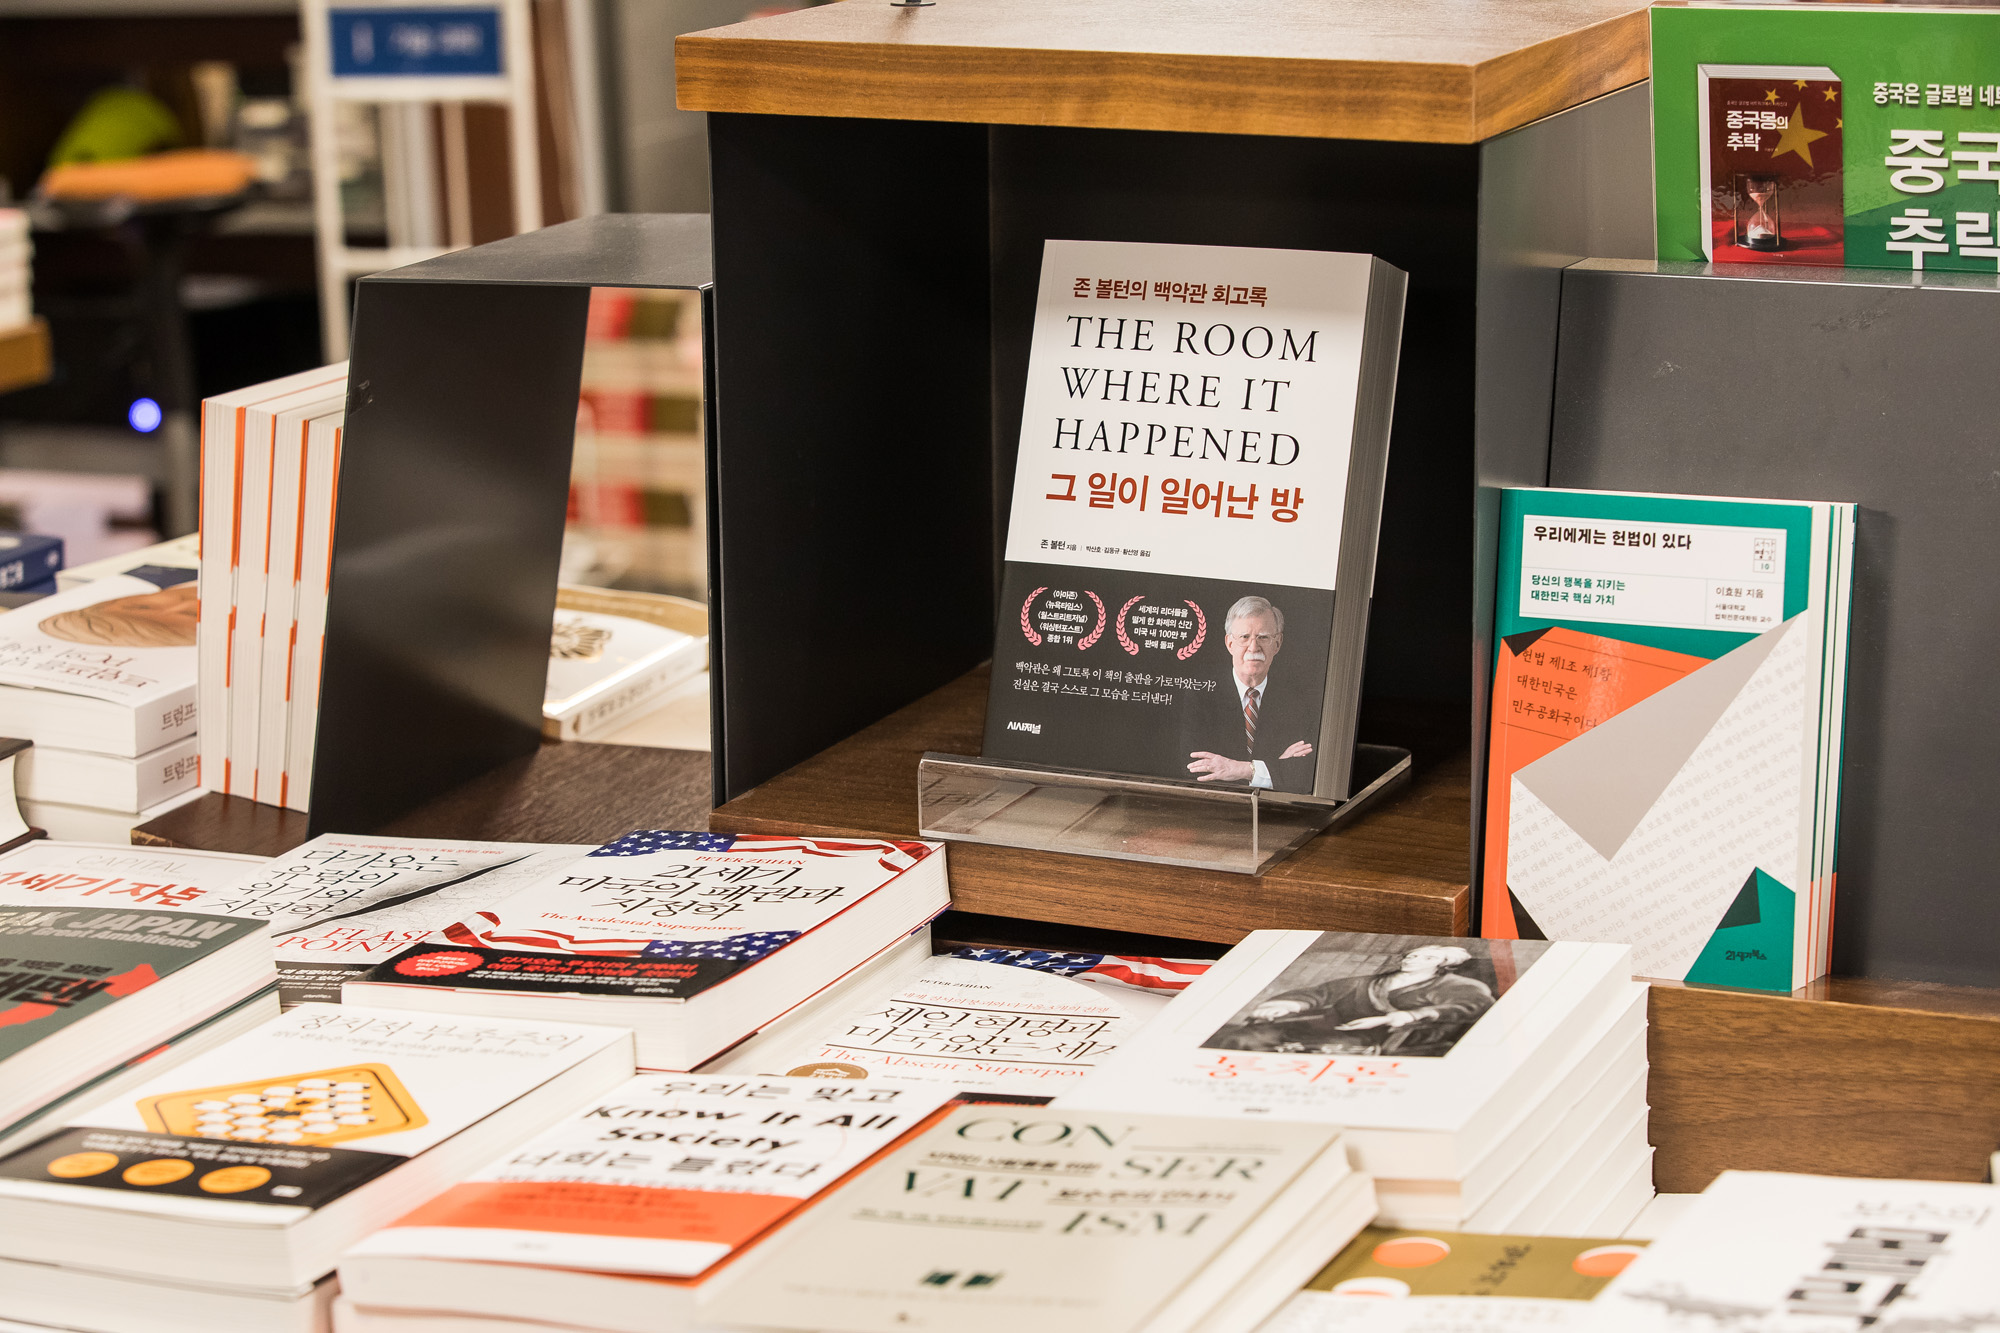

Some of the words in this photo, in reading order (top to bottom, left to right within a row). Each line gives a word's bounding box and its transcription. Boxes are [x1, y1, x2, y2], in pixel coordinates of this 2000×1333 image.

[1873, 82, 1920, 105] 중국은
[1925, 84, 1973, 106] 글로벌
[1979, 84, 2000, 107] 네
[1726, 110, 1788, 130] 중국몽의
[1727, 132, 1761, 152] 추락
[1073, 278, 1091, 298] 존
[1095, 278, 1148, 300] 볼턴의
[1153, 280, 1208, 304] 백악관
[1212, 285, 1268, 307] 회고록
[1066, 315, 1156, 352] THE
[1173, 321, 1320, 363] ROOM
[1060, 366, 1222, 408] WHERE
[1240, 378, 1291, 413] IT
[1052, 417, 1301, 466] HAPPENED
[1045, 473, 1077, 502] 그
[1088, 472, 1149, 511] 일이
[1160, 477, 1259, 520] 일어난
[1270, 487, 1304, 523] 방
[1041, 539, 1048, 548] 존
[1050, 540, 1065, 550] 볼턴
[1534, 525, 1607, 545] 우리에게는
[1612, 530, 1656, 548] 헌법이
[1662, 533, 1692, 550] 있다
[1531, 574, 1560, 587] 당신의
[1564, 576, 1592, 589] 행복을
[1596, 579, 1626, 591] 지키는
[1715, 587, 1743, 597] 이효원
[1746, 589, 1764, 599] 지음
[1531, 590, 1569, 602] 대한민국
[1573, 593, 1592, 604] 핵심
[1595, 594, 1615, 605] 가치
[1138, 605, 1159, 614] 세계의
[1161, 608, 1188, 618] 리더들을
[1147, 617, 1154, 625] 한
[1156, 618, 1176, 628] 화제의
[1178, 620, 1192, 629] 신간
[1047, 634, 1060, 643] 종합
[1063, 636, 1073, 644] 1위
[1134, 627, 1148, 636] 미국
[1150, 629, 1156, 637] 내
[1159, 630, 1178, 639] 100만
[1180, 632, 1187, 640] 부
[1145, 640, 1158, 648] 판매
[1160, 641, 1174, 650] 돌파
[1522, 649, 1545, 666] 헌법
[1549, 656, 1578, 672] 제1조
[1015, 661, 1050, 675] 백악관은
[1052, 665, 1062, 676] 왜
[1063, 667, 1091, 679] 그토록
[1092, 669, 1102, 680] 이
[1104, 670, 1122, 683] 책의
[1124, 671, 1153, 686] 출판을
[1013, 678, 1039, 692] 진실은
[1041, 681, 1060, 694] 결국
[1060, 684, 1088, 696] 스스로
[1090, 687, 1100, 697] 그
[1101, 688, 1130, 701] 모습을
[1131, 691, 1173, 705] 드러낸다!
[1517, 675, 1578, 700] 대한민국은
[161, 702, 197, 731] 트럼프
[1512, 700, 1598, 729] 민주공화국이다
[1007, 721, 1042, 735] 시사저널
[163, 755, 199, 784] 트럼프
[77, 855, 187, 874] CAPITAL
[303, 850, 459, 873] 다가오는
[695, 855, 747, 864] PETER
[748, 857, 807, 866] ZEIHAN
[272, 865, 399, 889] 유럽의
[652, 864, 803, 885] 21세기
[239, 881, 365, 904] 위기와
[559, 876, 701, 899] 미국의
[698, 885, 845, 905] 패권과
[211, 899, 334, 920] 지정학
[591, 897, 744, 921] 지정학
[67, 913, 238, 940] JAPAN
[541, 912, 569, 921] The
[573, 914, 654, 926] Accidental
[654, 921, 746, 933] Superpower
[31, 927, 95, 938] Great
[88, 930, 202, 949] Ambitions
[920, 978, 951, 987] PETER
[302, 1014, 413, 1038] 정치적
[846, 1025, 946, 1050] 미국
[938, 1034, 1040, 1056] 없는
[819, 1046, 877, 1065] The
[871, 1054, 960, 1071] Absent
[652, 1081, 791, 1099] 우리는
[582, 1105, 745, 1121] Know
[760, 1111, 803, 1125] It
[816, 1114, 899, 1129] All
[599, 1126, 800, 1154] Society
[957, 1117, 1138, 1149] CON
[510, 1151, 653, 1172] 너희는
[1109, 1155, 1264, 1182] SER
[904, 1169, 1050, 1202] VAT
[1060, 1209, 1209, 1237] ISM
